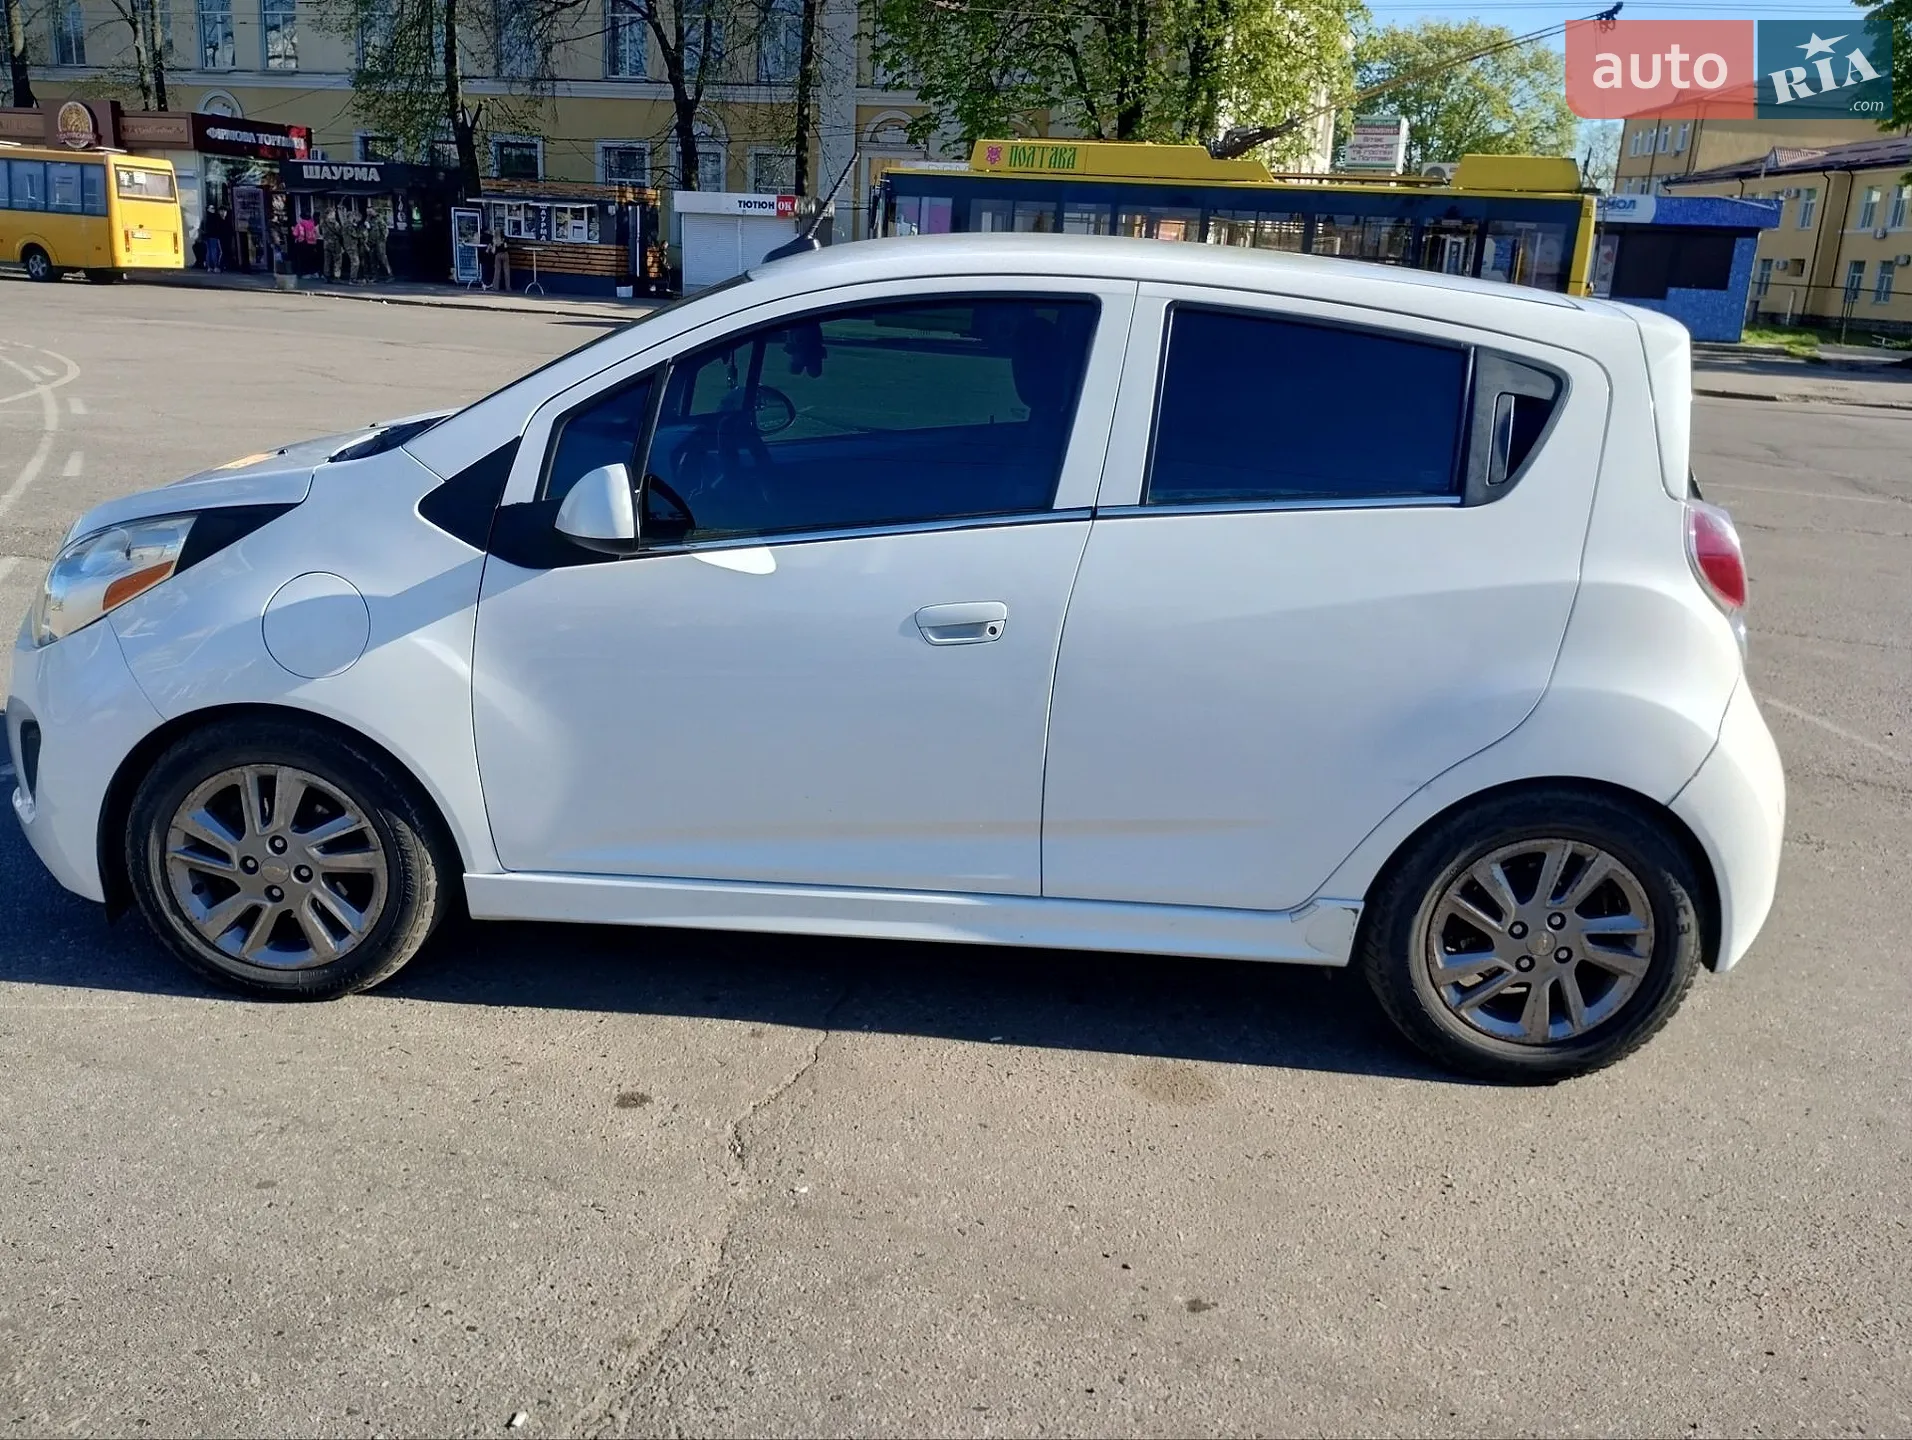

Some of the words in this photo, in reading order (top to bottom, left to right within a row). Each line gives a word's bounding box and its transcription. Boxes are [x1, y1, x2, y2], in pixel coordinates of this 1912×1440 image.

[1008, 145, 1077, 169] ПОЛТАВА
[302, 164, 381, 182] ШАУРМА
[737, 199, 775, 210] ТЮТЮН
[777, 200, 793, 211] ОК
